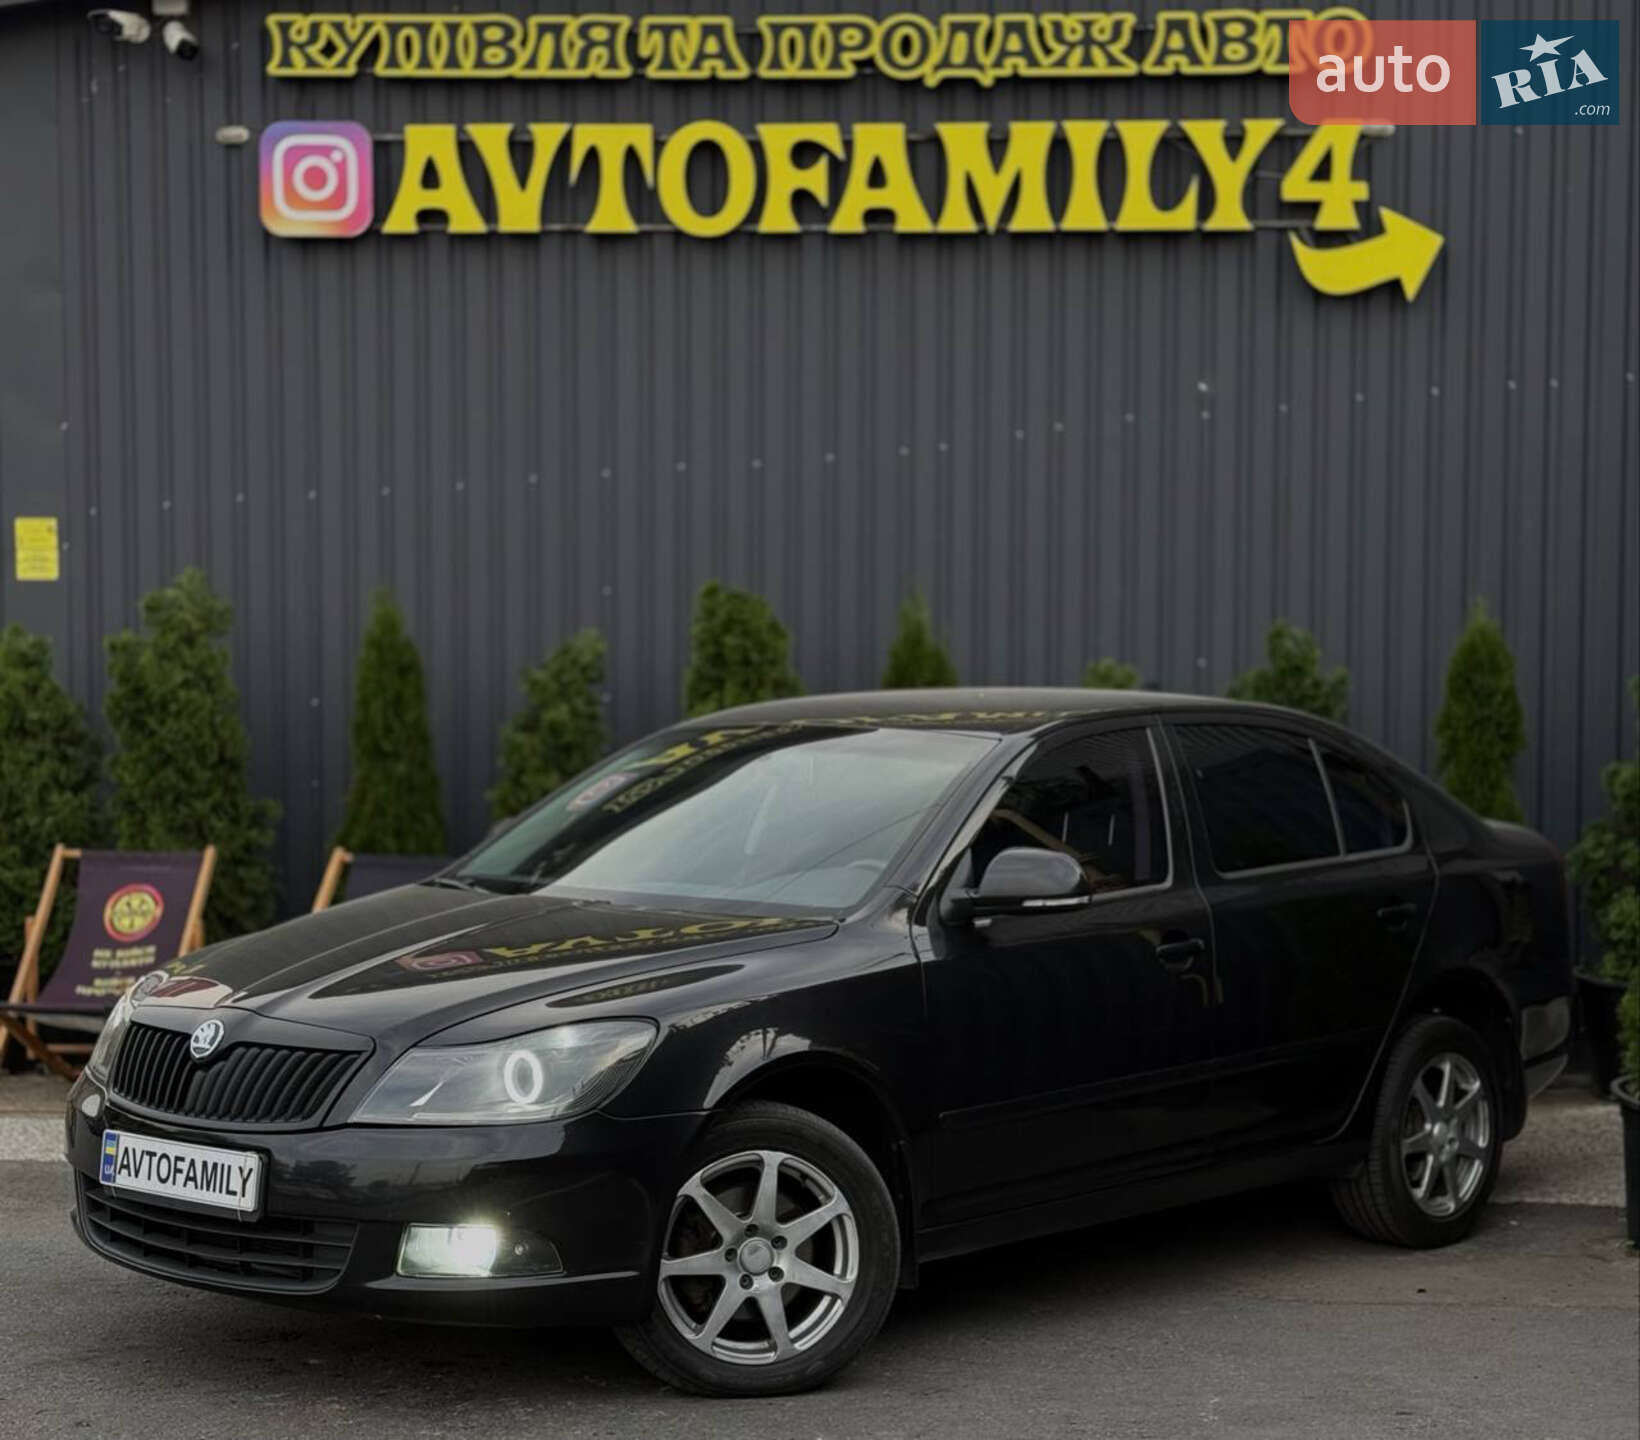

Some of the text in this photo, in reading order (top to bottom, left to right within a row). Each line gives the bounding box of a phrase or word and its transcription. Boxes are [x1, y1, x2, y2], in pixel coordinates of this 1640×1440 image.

[266, 7, 1374, 88] КУПІВЛЯ ТА ПРОДАЖ АВТО
[117, 1146, 254, 1198] AVTOFAMILY
